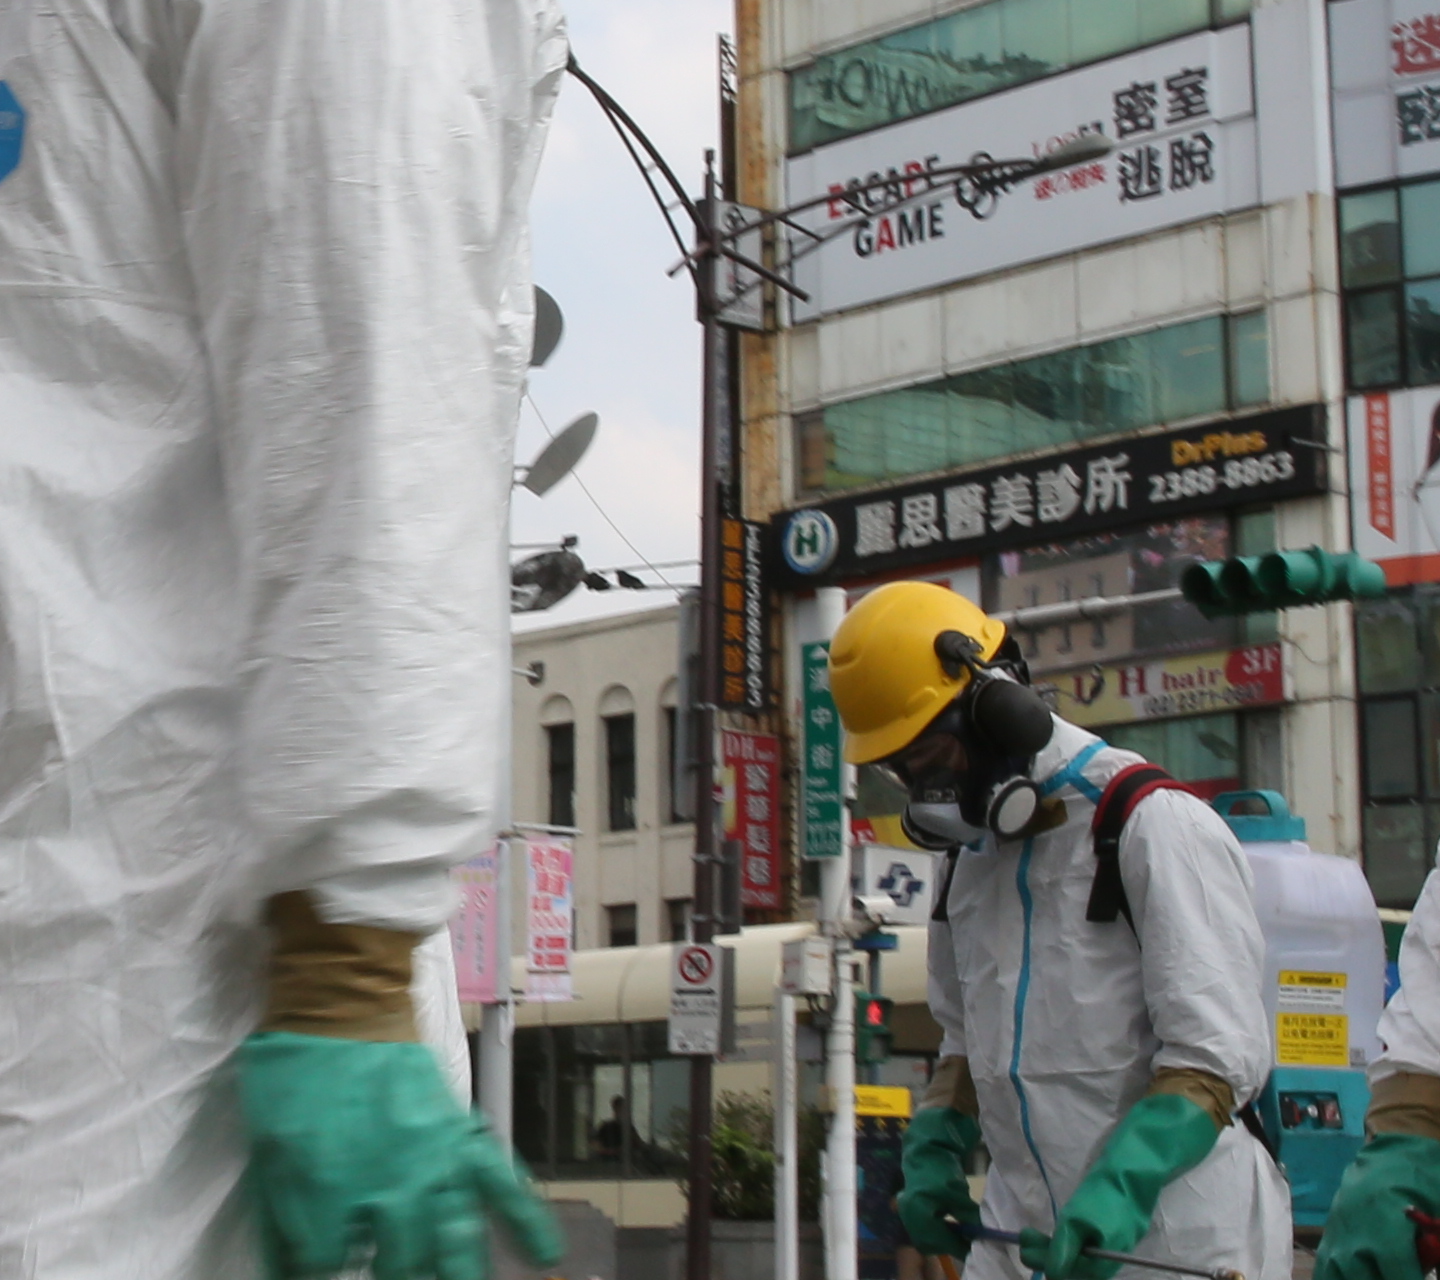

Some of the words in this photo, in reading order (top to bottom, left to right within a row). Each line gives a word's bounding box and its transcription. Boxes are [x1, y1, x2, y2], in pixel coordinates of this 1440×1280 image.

[1112, 65, 1211, 139] 密室
[827, 153, 942, 220] ESCAPE
[1118, 131, 1216, 206] 逃脫
[853, 202, 946, 259] GAME
[1148, 451, 1296, 504] 2388-8863
[1161, 667, 1223, 693] hair
